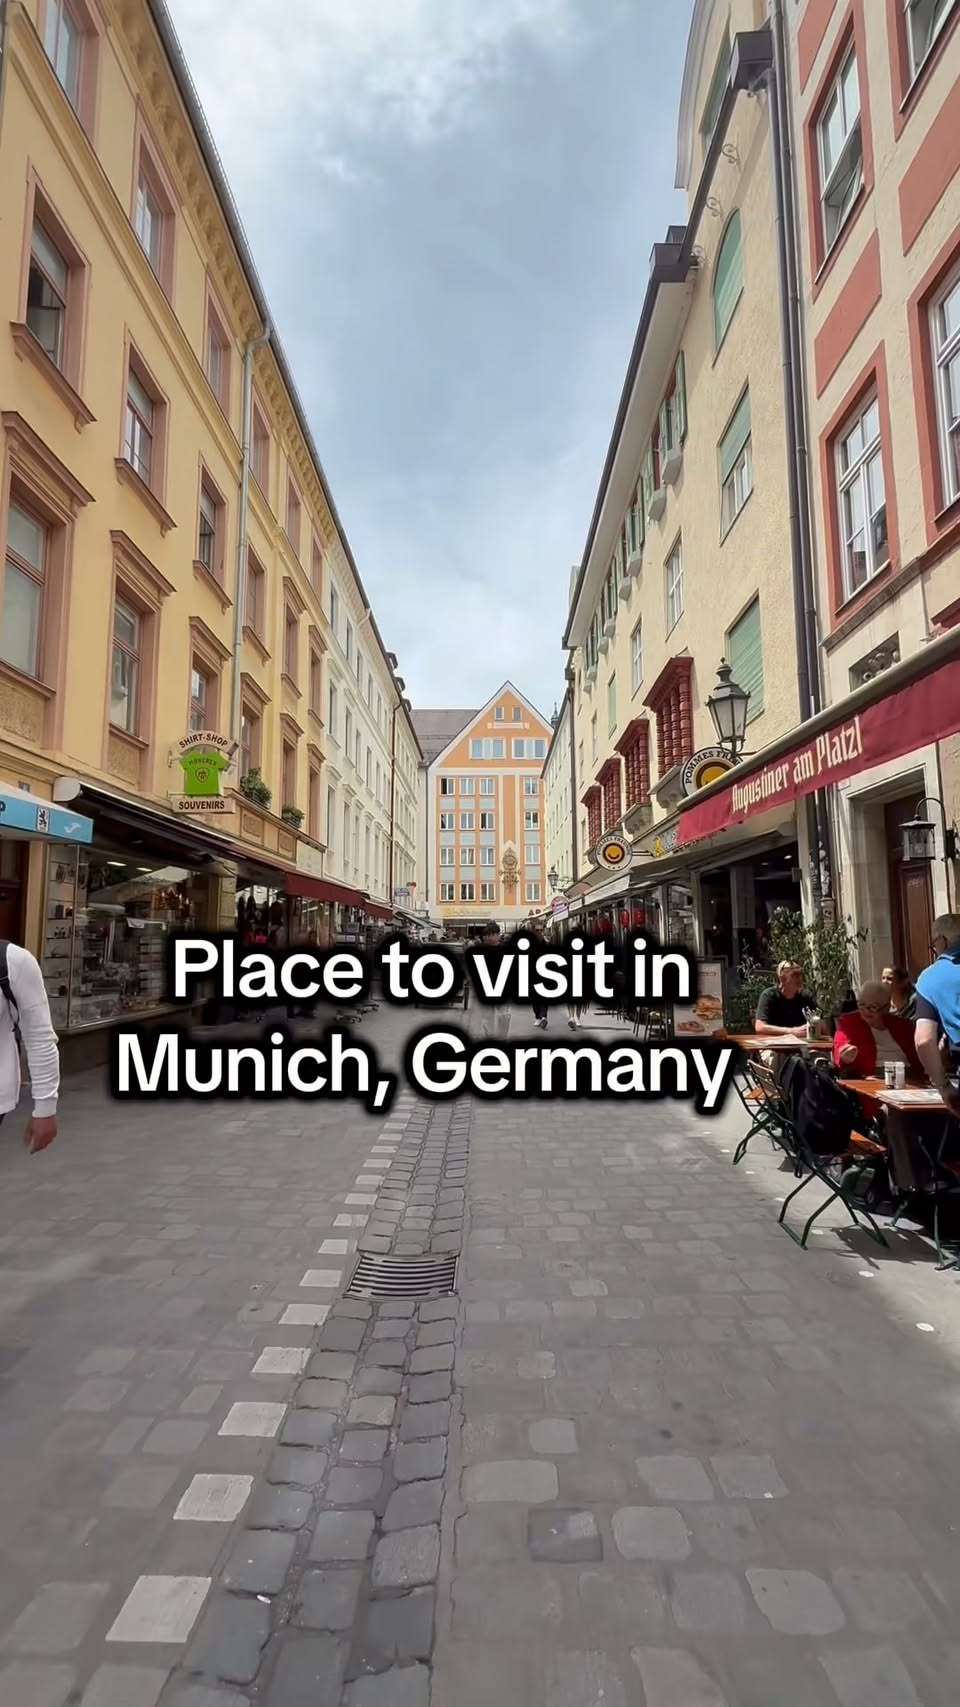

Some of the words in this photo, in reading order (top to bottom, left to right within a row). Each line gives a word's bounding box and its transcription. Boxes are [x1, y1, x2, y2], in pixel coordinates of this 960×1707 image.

[178, 733, 228, 749] SHIRT-SHOP
[685, 750, 714, 785] POMMES
[731, 762, 789, 814] Augustiner
[792, 749, 814, 784] am
[815, 714, 863, 775] Platzl
[178, 800, 225, 810] SOUVENIRS
